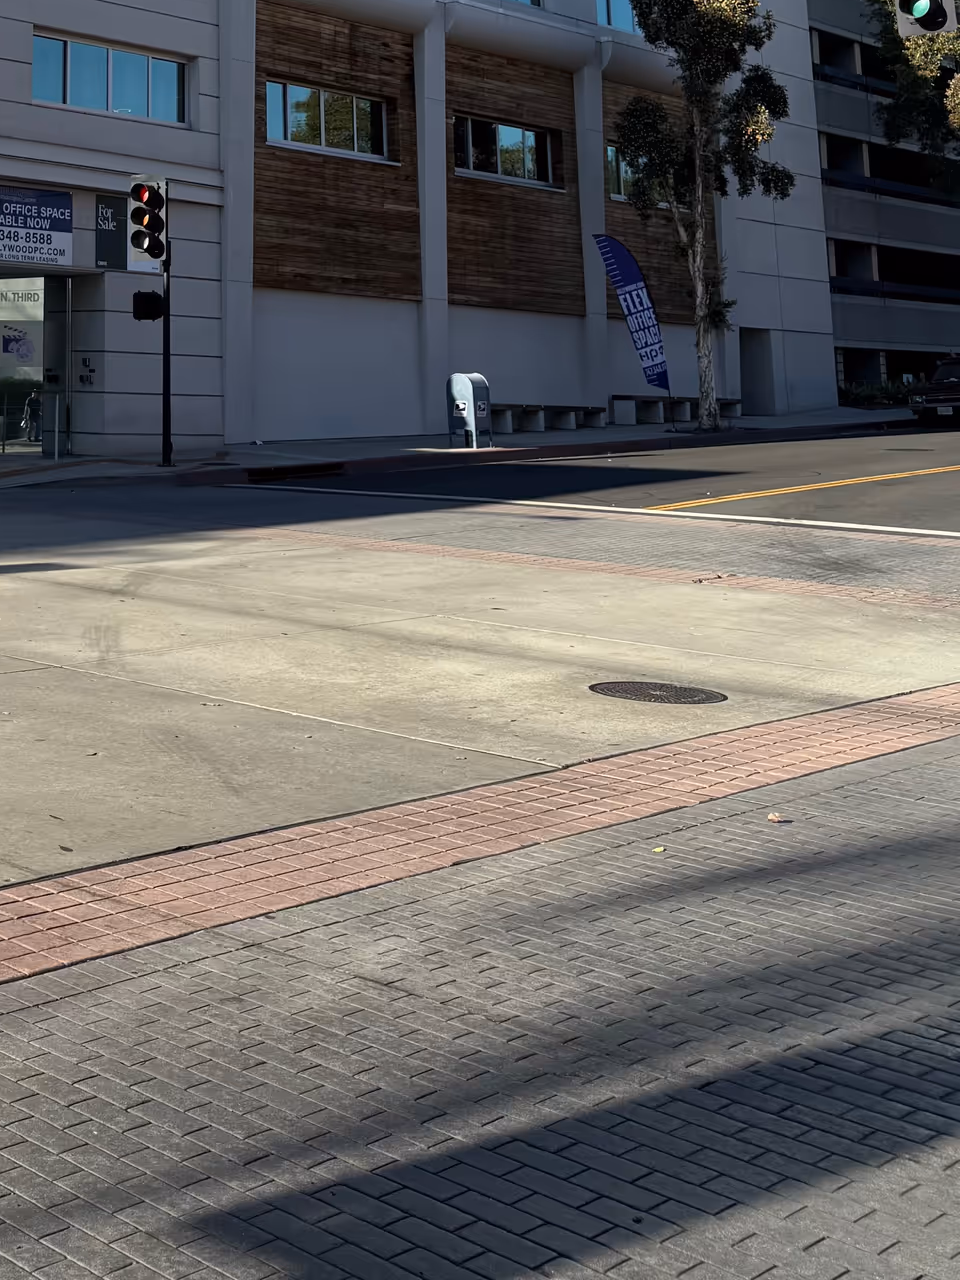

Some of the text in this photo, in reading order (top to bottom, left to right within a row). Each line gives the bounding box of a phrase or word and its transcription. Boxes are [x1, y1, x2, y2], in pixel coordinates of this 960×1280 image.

[3, 203, 38, 216] OFFICE
[40, 206, 71, 220] SPACE
[98, 204, 113, 217] For
[26, 217, 51, 230] NOW
[97, 217, 117, 231] Sale
[21, 254, 35, 262] TERM
[36, 256, 59, 264] LEASING
[11, 292, 40, 303] THIRD
[618, 287, 652, 316] FLEX
[626, 307, 657, 332] OFFICE
